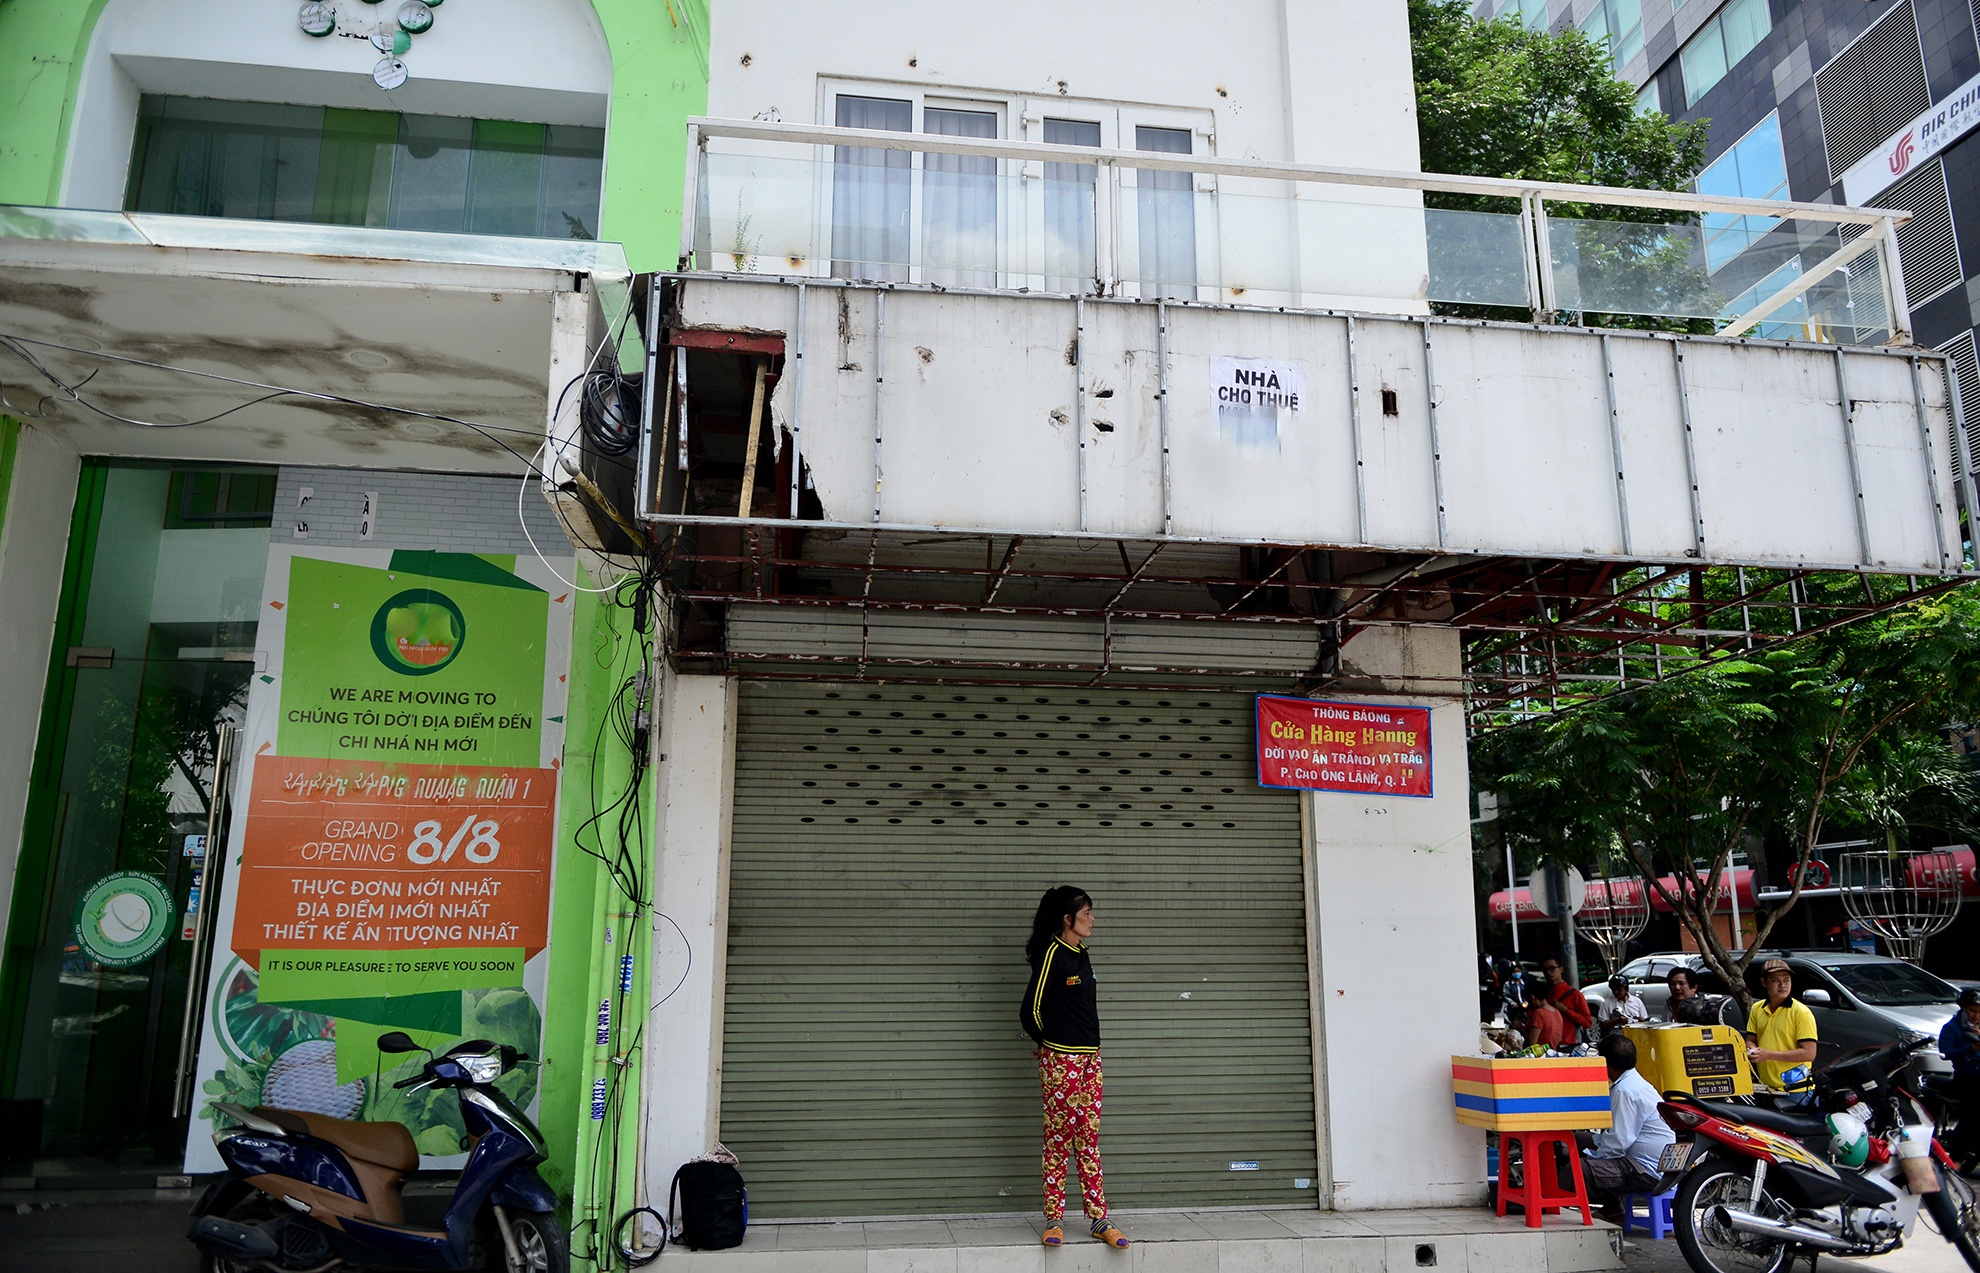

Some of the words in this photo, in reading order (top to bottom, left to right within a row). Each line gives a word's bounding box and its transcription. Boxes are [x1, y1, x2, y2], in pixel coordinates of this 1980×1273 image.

[1922, 110, 1946, 140] AIR
[1950, 84, 1980, 119] CHI
[1235, 368, 1281, 390] NHÀ
[1218, 386, 1251, 405] CHO
[1256, 392, 1299, 412] THUÊ
[330, 688, 357, 701] WE
[360, 689, 394, 703] ARE
[398, 691, 470, 705] MOVING
[474, 692, 497, 705] TO
[288, 707, 349, 725] CHÚNG
[353, 709, 380, 726] TÔI
[422, 715, 450, 732] ĐỊA
[454, 712, 495, 729] ĐIỂM
[498, 713, 532, 729] ĐẾN
[1312, 706, 1350, 721] THÔNG
[339, 735, 368, 749] CHI
[444, 735, 478, 752] MỚI
[1271, 720, 1305, 740] Cửa
[1310, 724, 1356, 747] Hàng
[1265, 746, 1285, 760] DỜI
[1280, 767, 1292, 779] P.
[522, 778, 532, 800] 1
[325, 819, 399, 840] GRAND
[406, 813, 501, 865] 8/8
[301, 842, 396, 862] OPENING
[291, 879, 346, 899] THỰC
[407, 877, 444, 897] MỚI
[450, 877, 501, 896] NHẤT
[297, 902, 330, 922] ĐỊA
[335, 899, 385, 919] ĐIỂM
[439, 899, 491, 918] NHẤT
[263, 920, 318, 940] THIẾT
[322, 921, 351, 940] KẾ
[352, 921, 380, 941] ẤN
[468, 921, 520, 941] NHẤT
[268, 961, 280, 971] IT
[282, 961, 293, 971] IS
[296, 961, 322, 971] OUR
[395, 962, 411, 973] TO
[413, 961, 449, 972] SERVE
[453, 961, 477, 971] YOU
[480, 961, 515, 972] SOON
